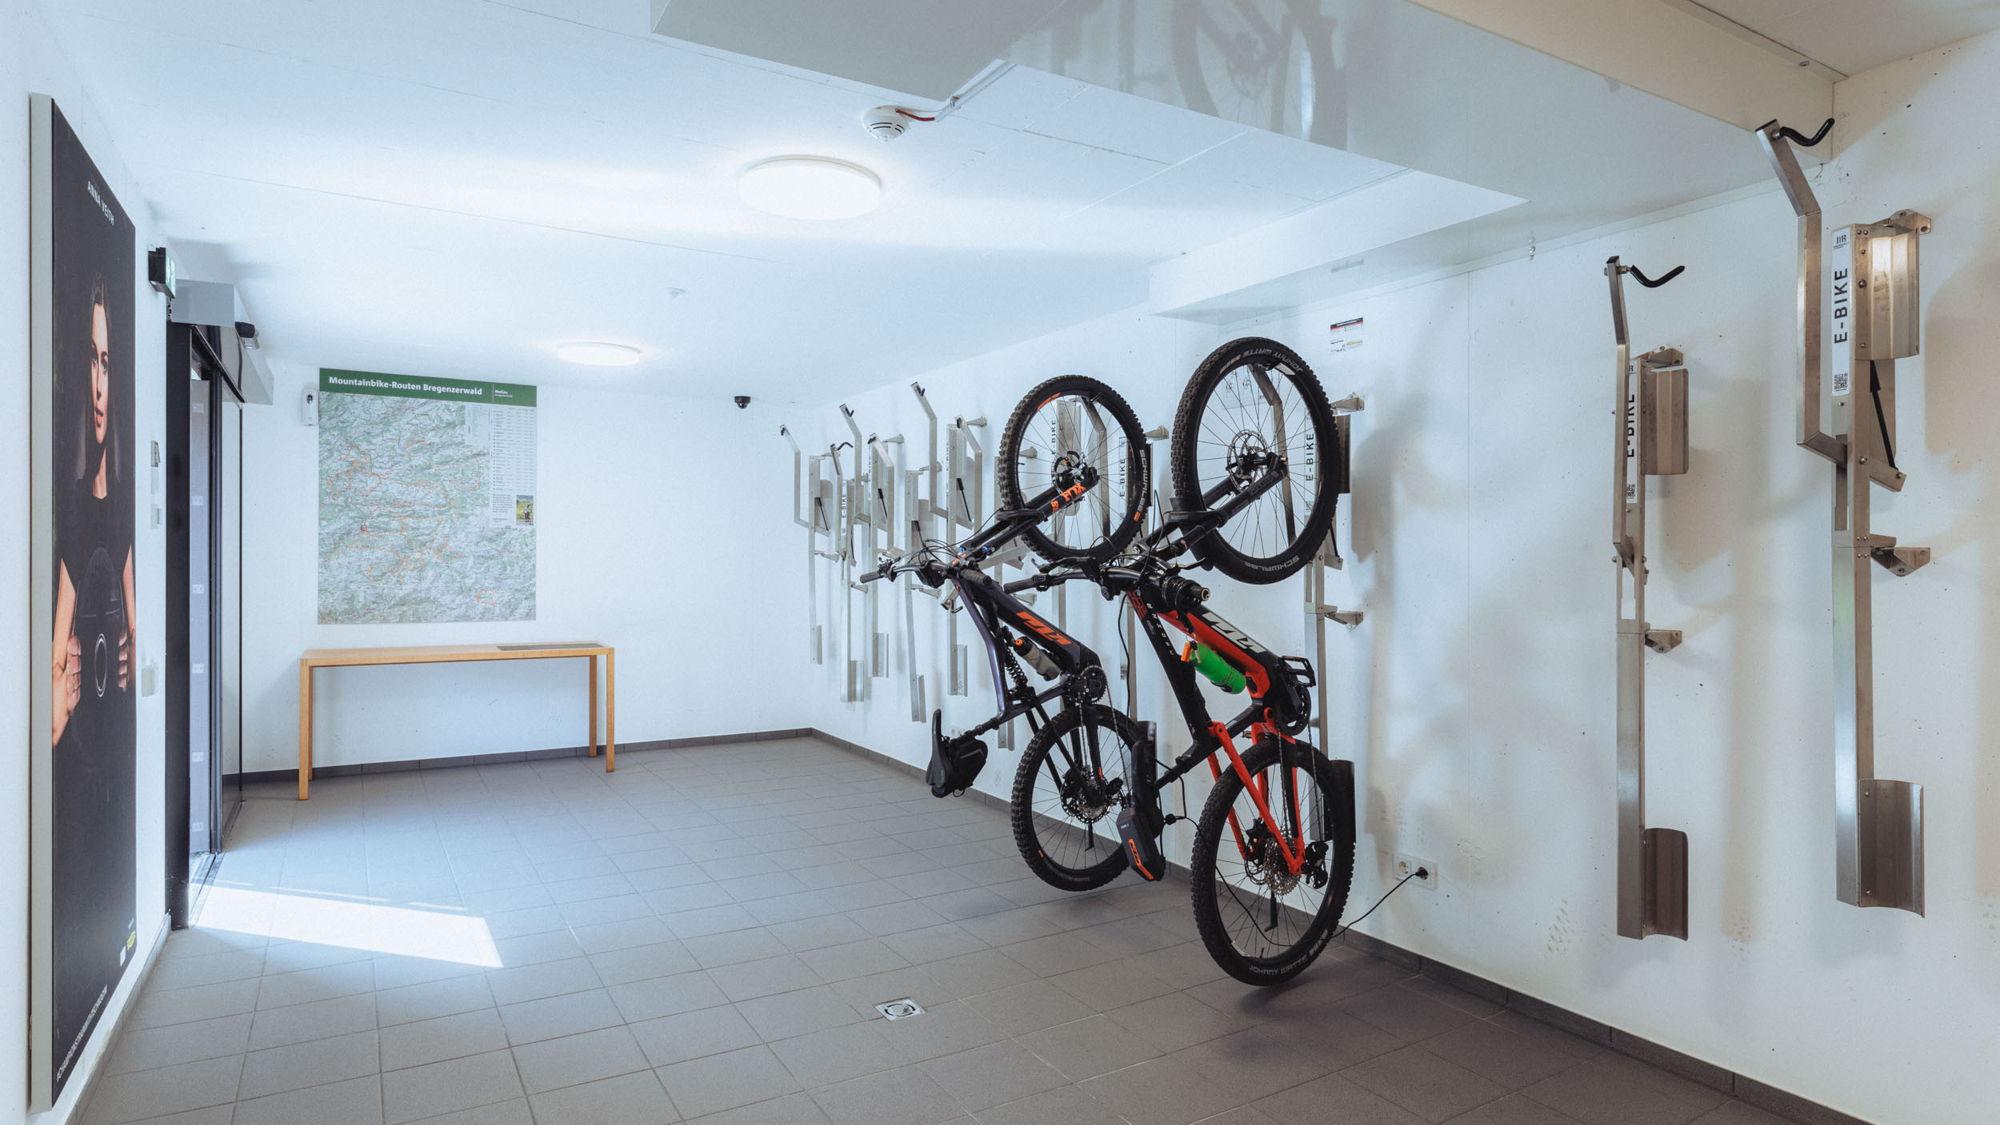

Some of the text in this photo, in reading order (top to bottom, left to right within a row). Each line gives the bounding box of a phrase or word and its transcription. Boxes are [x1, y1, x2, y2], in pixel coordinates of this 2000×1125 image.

[1834, 268, 1848, 344] E-BIKE
[328, 376, 422, 391] Mountainbike-Routen
[423, 383, 483, 395] Bregenzerwald
[1306, 433, 1315, 481] E-BIKE
[1060, 482, 1087, 502] FOX
[1139, 449, 1149, 513] SCHWALBE
[1244, 554, 1300, 572] SCHWALBE
[1016, 611, 1073, 646] KTM
[1201, 611, 1267, 654] KTM
